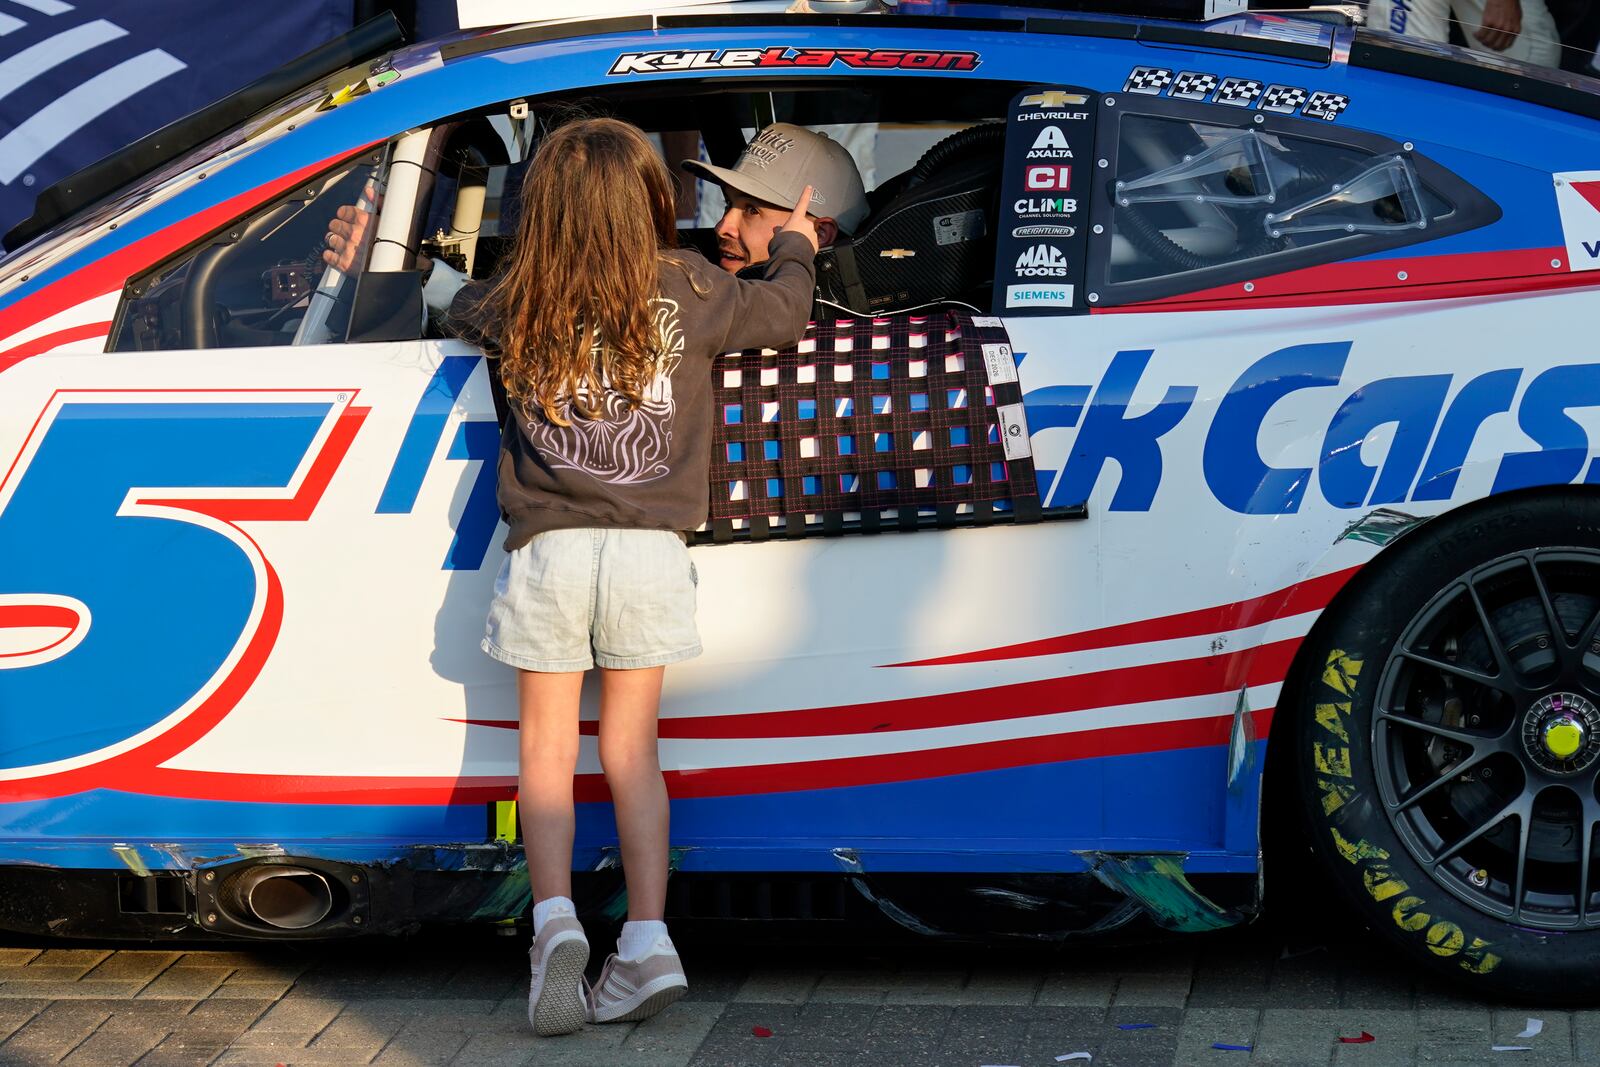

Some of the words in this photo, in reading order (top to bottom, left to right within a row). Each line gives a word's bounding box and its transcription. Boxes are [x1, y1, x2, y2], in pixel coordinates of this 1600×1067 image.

[1017, 112, 1089, 121] CHEVROLET
[1322, 110, 1337, 121] 16
[1026, 150, 1074, 158] AXALTA
[1028, 167, 1069, 188] CI
[1018, 227, 1069, 235] FREIGHTLINER
[1015, 244, 1067, 268] MAC
[1015, 267, 1067, 276] TOOLS
[1014, 291, 1065, 300] SIEMENS
